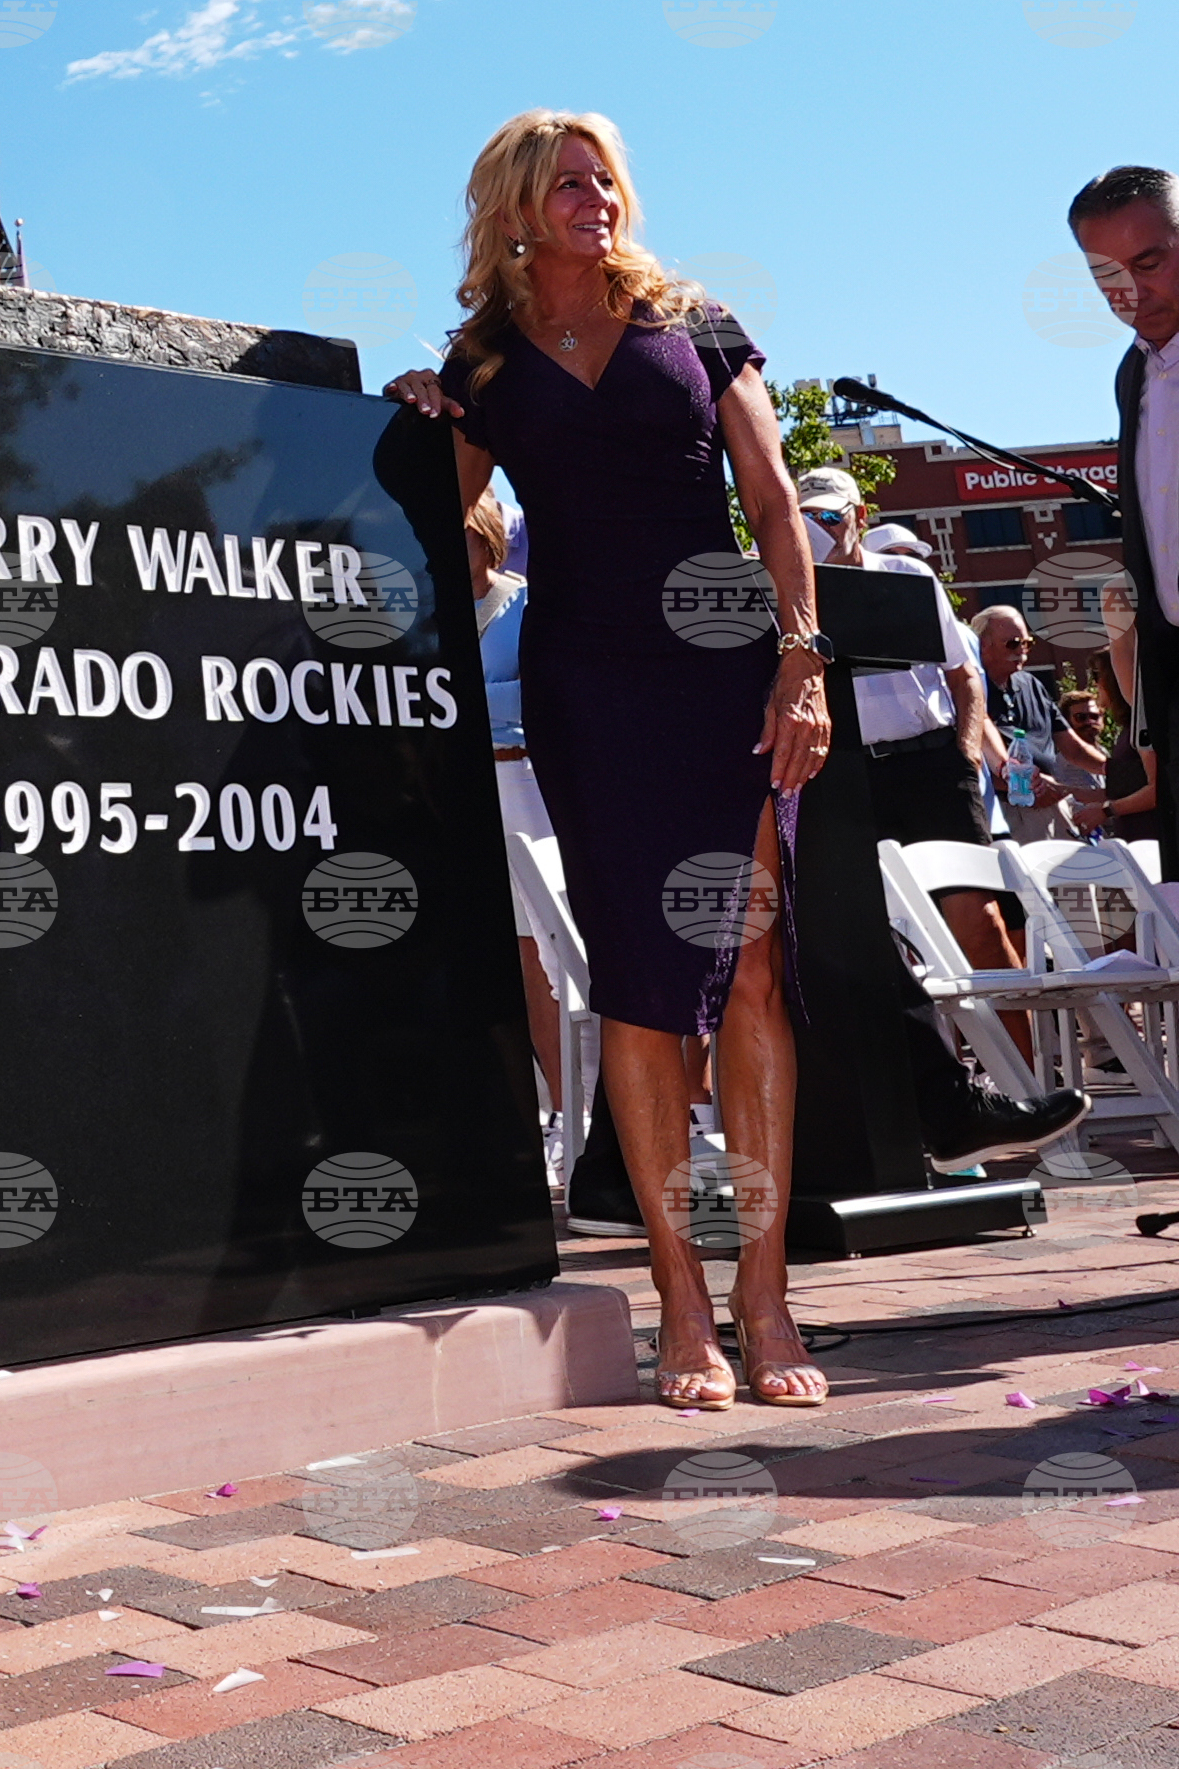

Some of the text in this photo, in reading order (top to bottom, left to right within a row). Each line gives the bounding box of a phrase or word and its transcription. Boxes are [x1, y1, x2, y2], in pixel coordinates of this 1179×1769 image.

[964, 470, 1038, 491] Public
[126, 524, 368, 607] WALKER
[201, 654, 459, 730] ROCKIES
